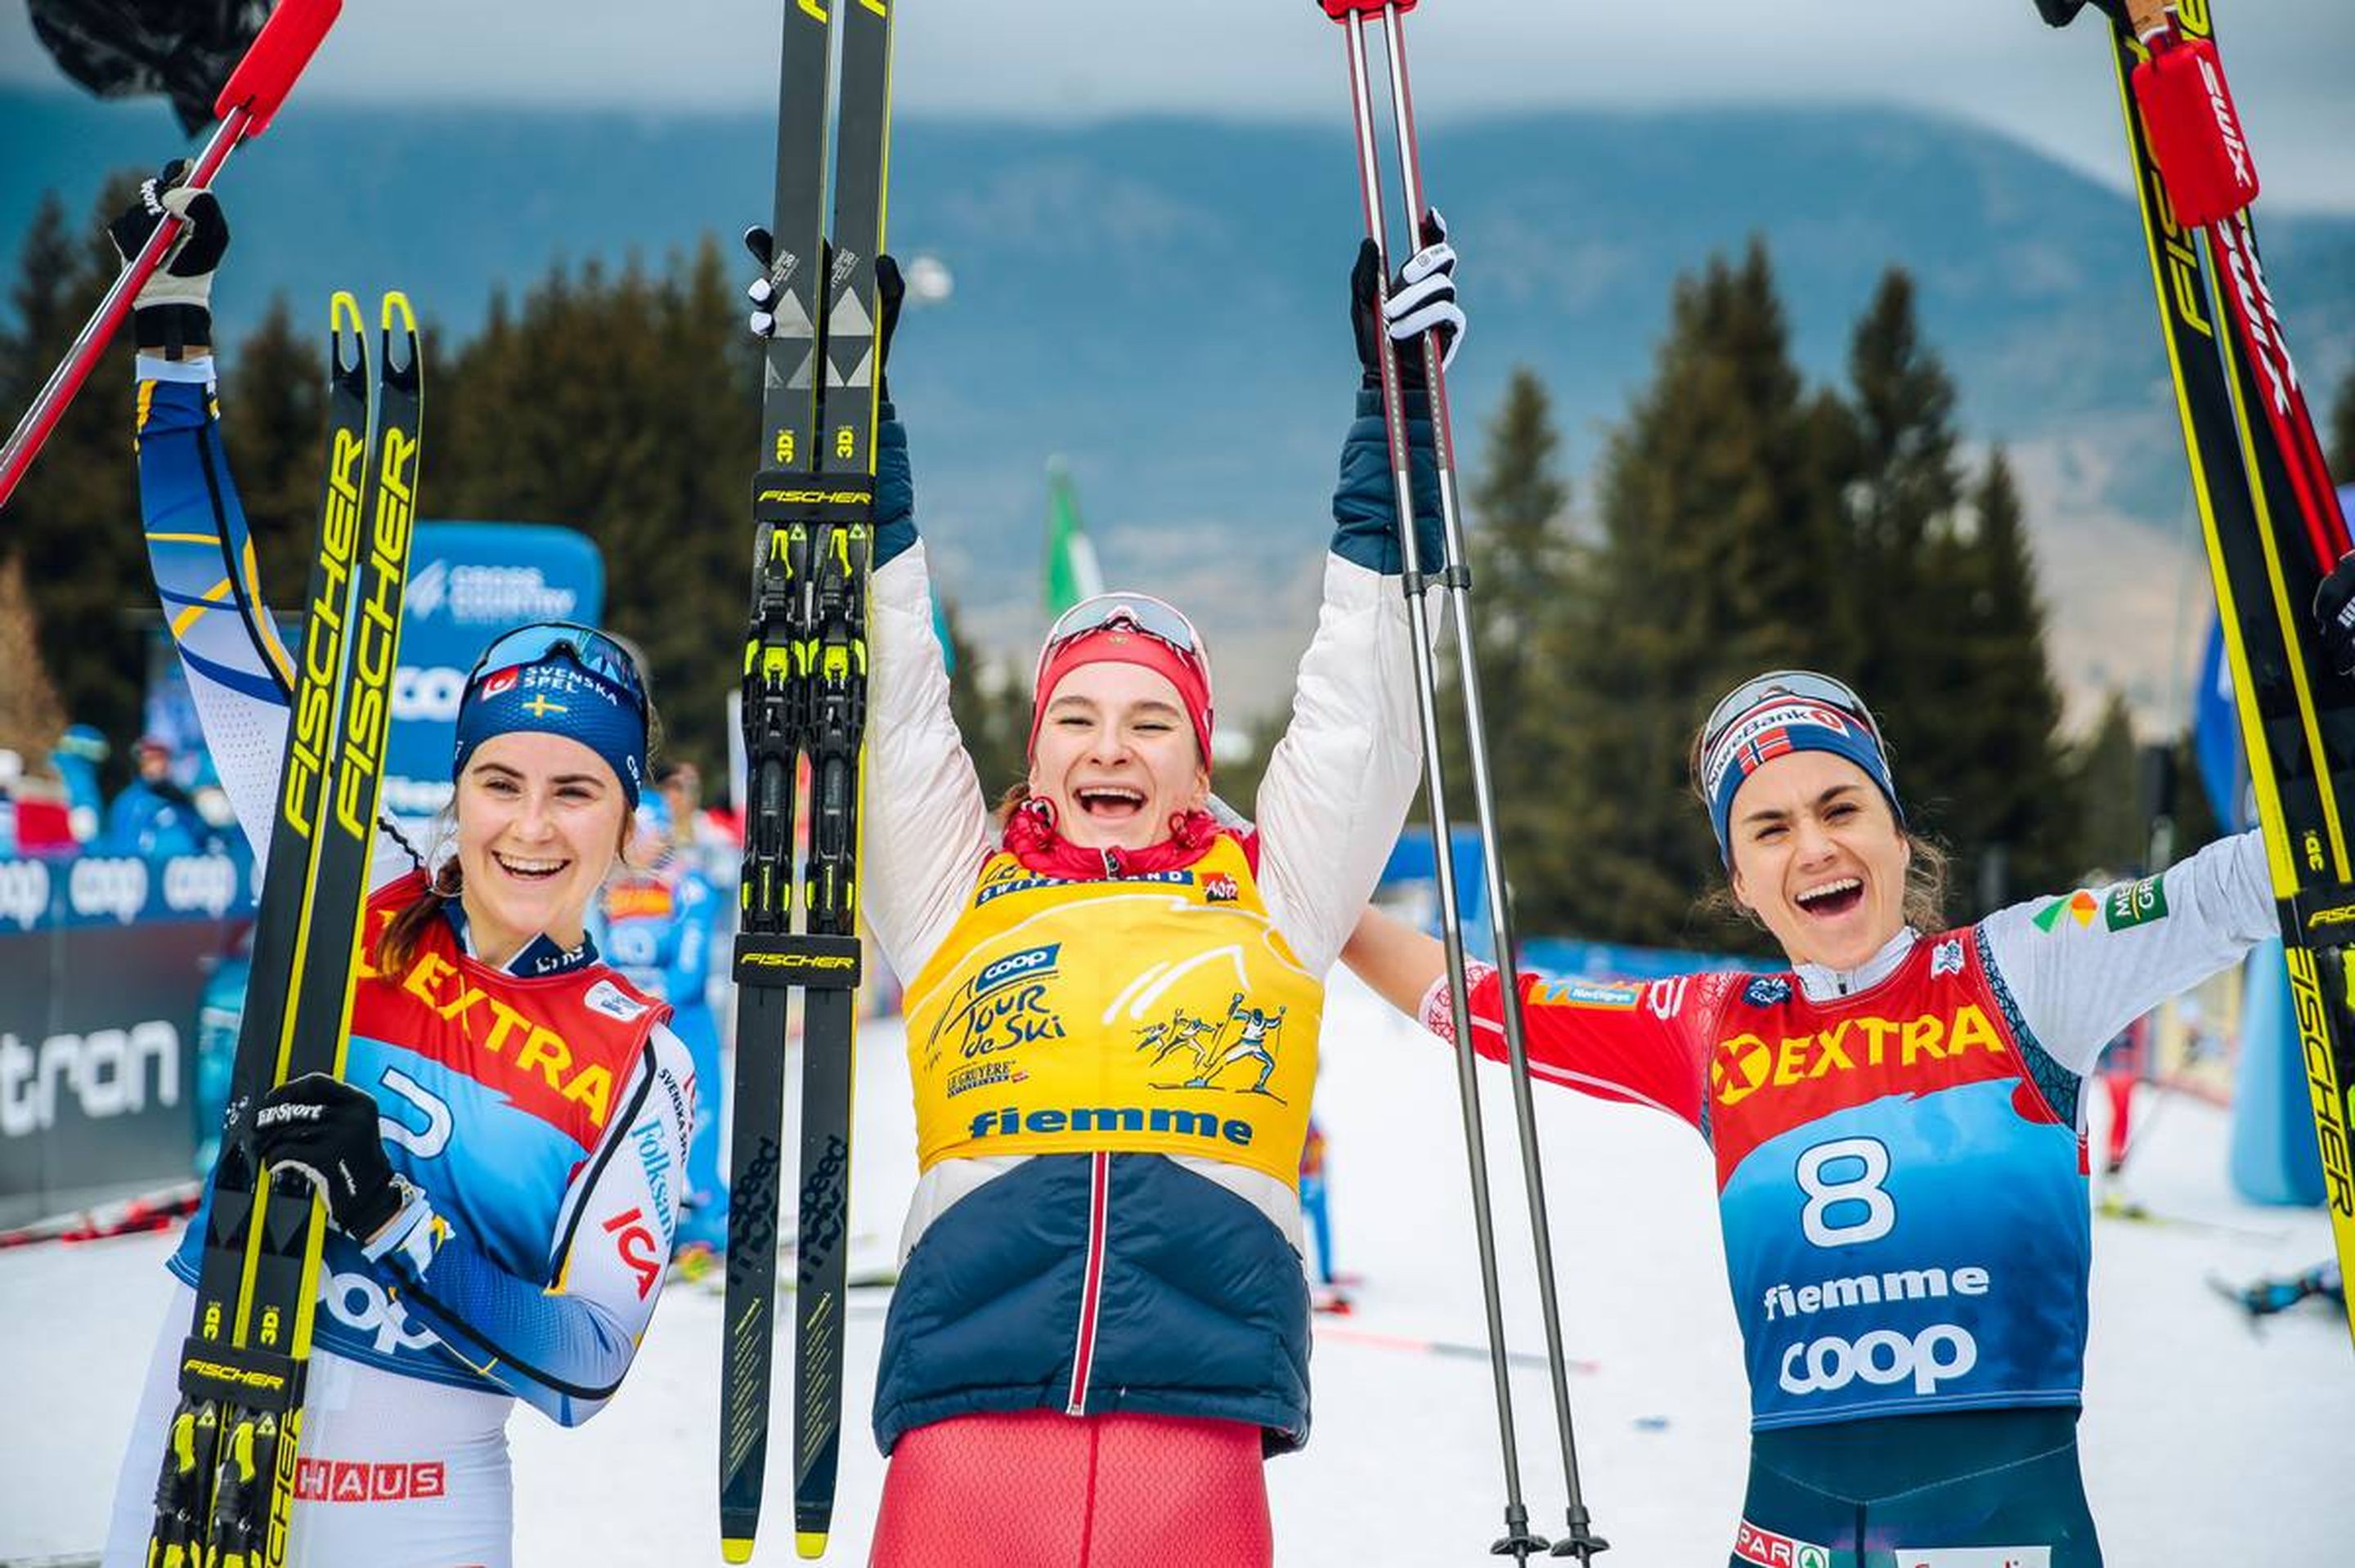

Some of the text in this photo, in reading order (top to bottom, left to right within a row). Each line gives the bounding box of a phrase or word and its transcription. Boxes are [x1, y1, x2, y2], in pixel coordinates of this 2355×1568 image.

[757, 490, 872, 505] FISCHER
[285, 428, 364, 838] FISCHER
[336, 427, 415, 841] FISCHER
[523, 676, 579, 694] SPEL
[525, 665, 618, 706] SVENSKA
[740, 952, 855, 970] FISCHER
[985, 951, 1047, 979] coop
[401, 952, 614, 1129] EXTRA
[965, 1035, 995, 1059] de
[1773, 1004, 2007, 1086] EXTRA
[969, 1106, 1254, 1145] fiemme
[1795, 1136, 1896, 1248] 8
[1763, 1266, 1990, 1322] fiemme
[183, 1358, 285, 1390] FISCHER
[1779, 1323, 1978, 1395] coop
[298, 1468, 440, 1499] HAUS
